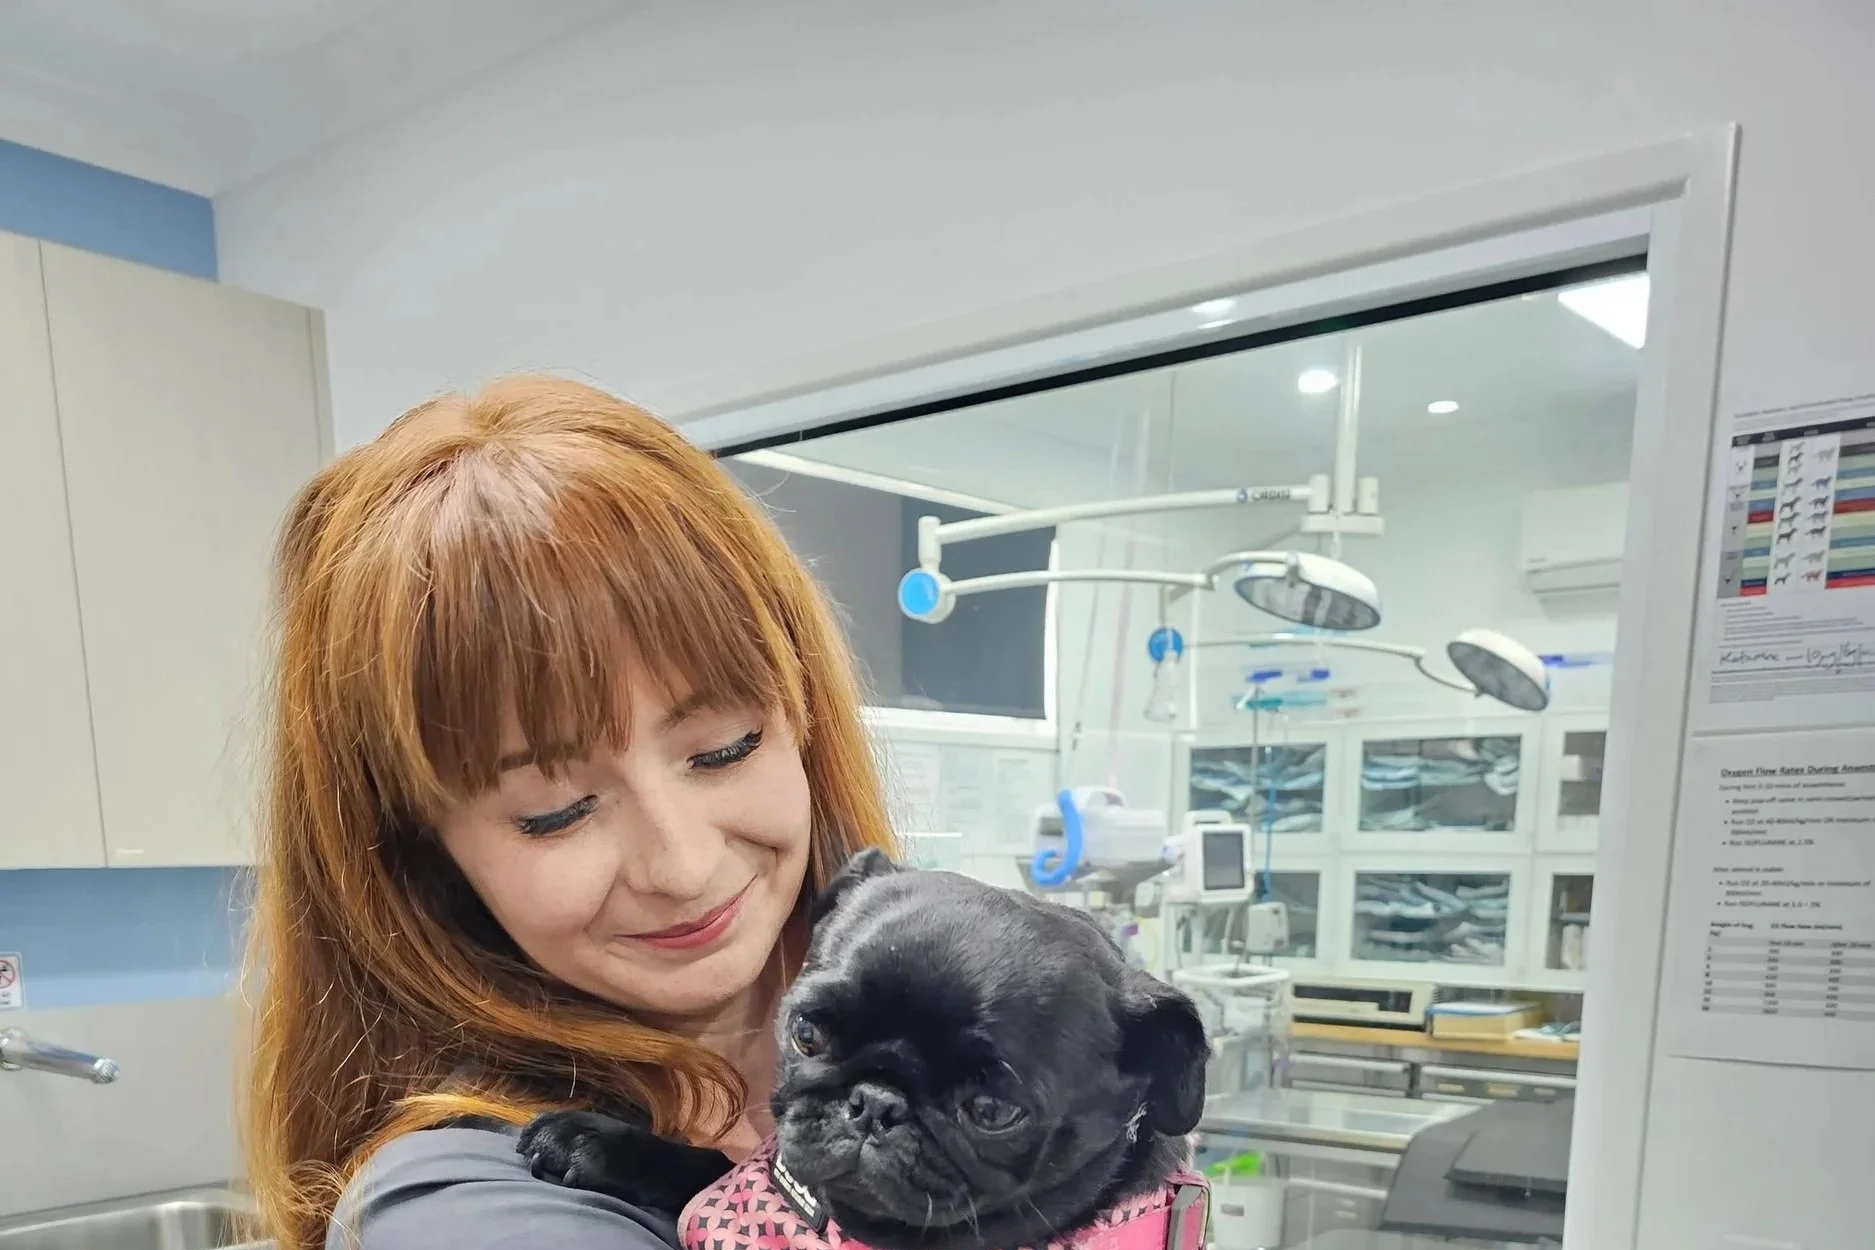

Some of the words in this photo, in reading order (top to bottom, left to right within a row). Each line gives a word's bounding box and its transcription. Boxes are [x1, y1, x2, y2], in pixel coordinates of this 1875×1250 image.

[1721, 768, 1753, 777] Oxygen
[1756, 767, 1776, 776] Flow
[1780, 766, 1804, 775] Rates
[1807, 765, 1839, 774] During
